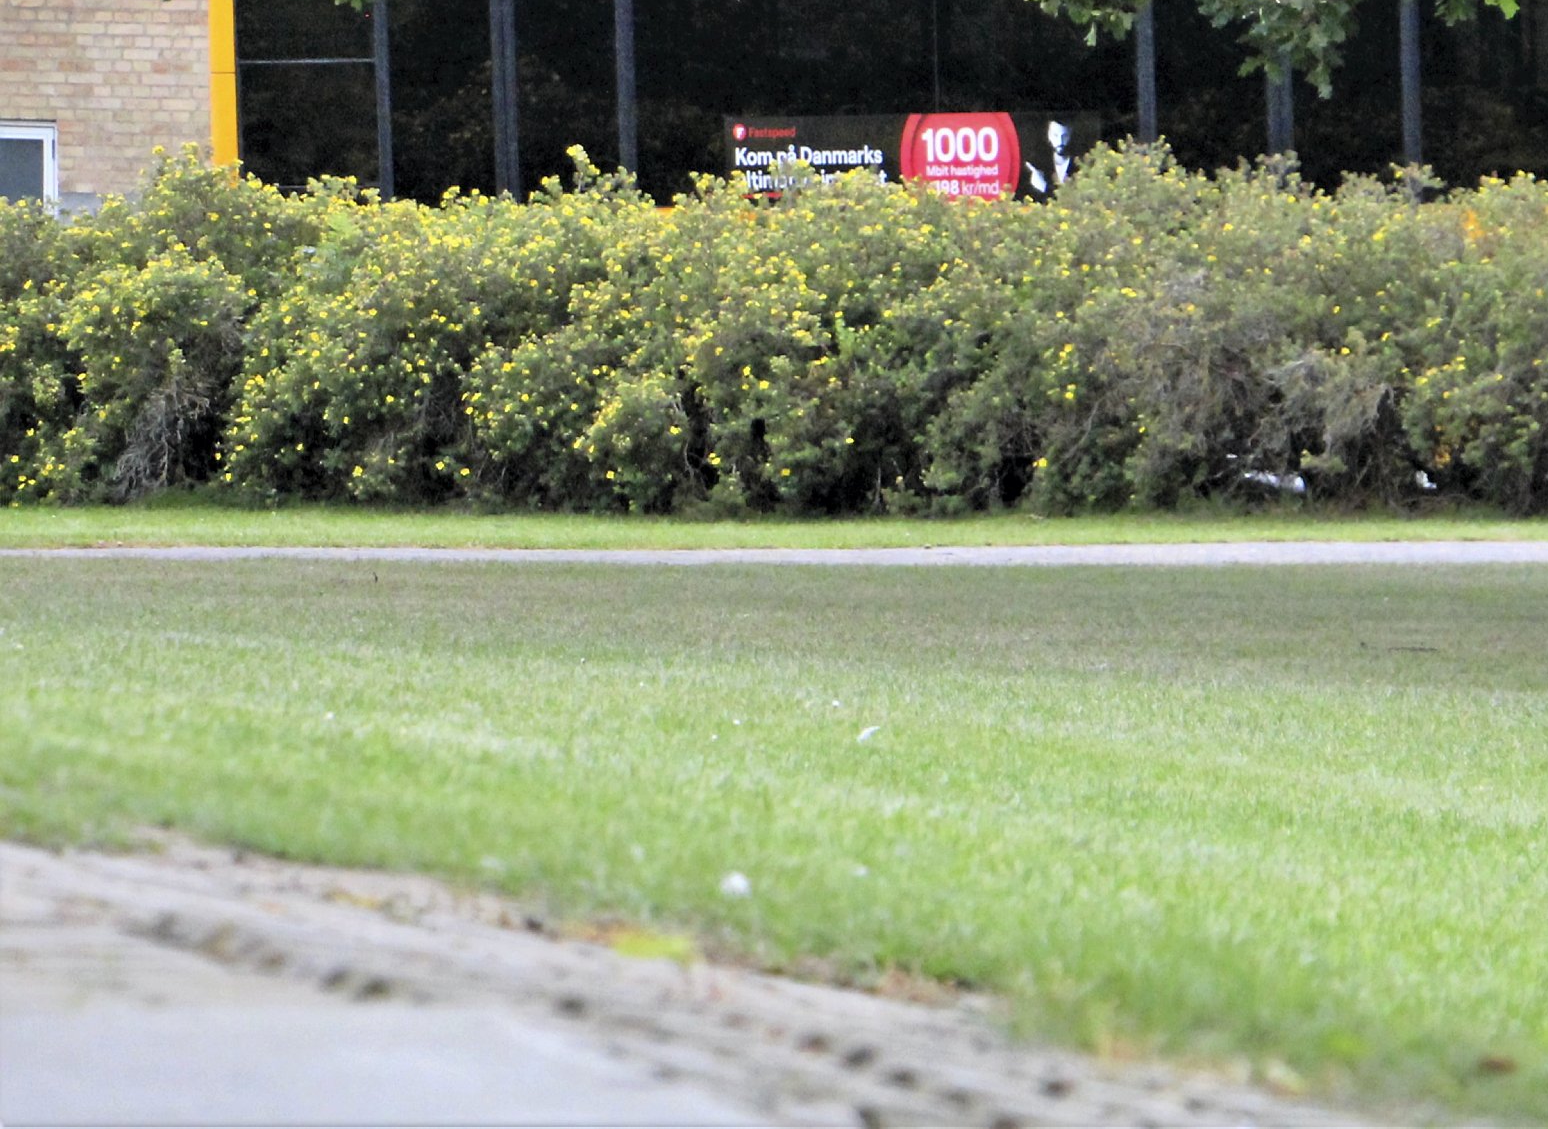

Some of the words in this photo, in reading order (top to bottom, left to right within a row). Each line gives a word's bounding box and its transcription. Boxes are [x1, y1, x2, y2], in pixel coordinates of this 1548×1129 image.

[749, 126, 797, 138] Fastspeed
[922, 127, 999, 162] 1000
[735, 146, 773, 166] Kom
[777, 144, 797, 168] på
[800, 144, 883, 165] Danmarks
[926, 164, 949, 176] Mbit
[950, 163, 999, 179] hastighed
[962, 179, 999, 195] kr/md
